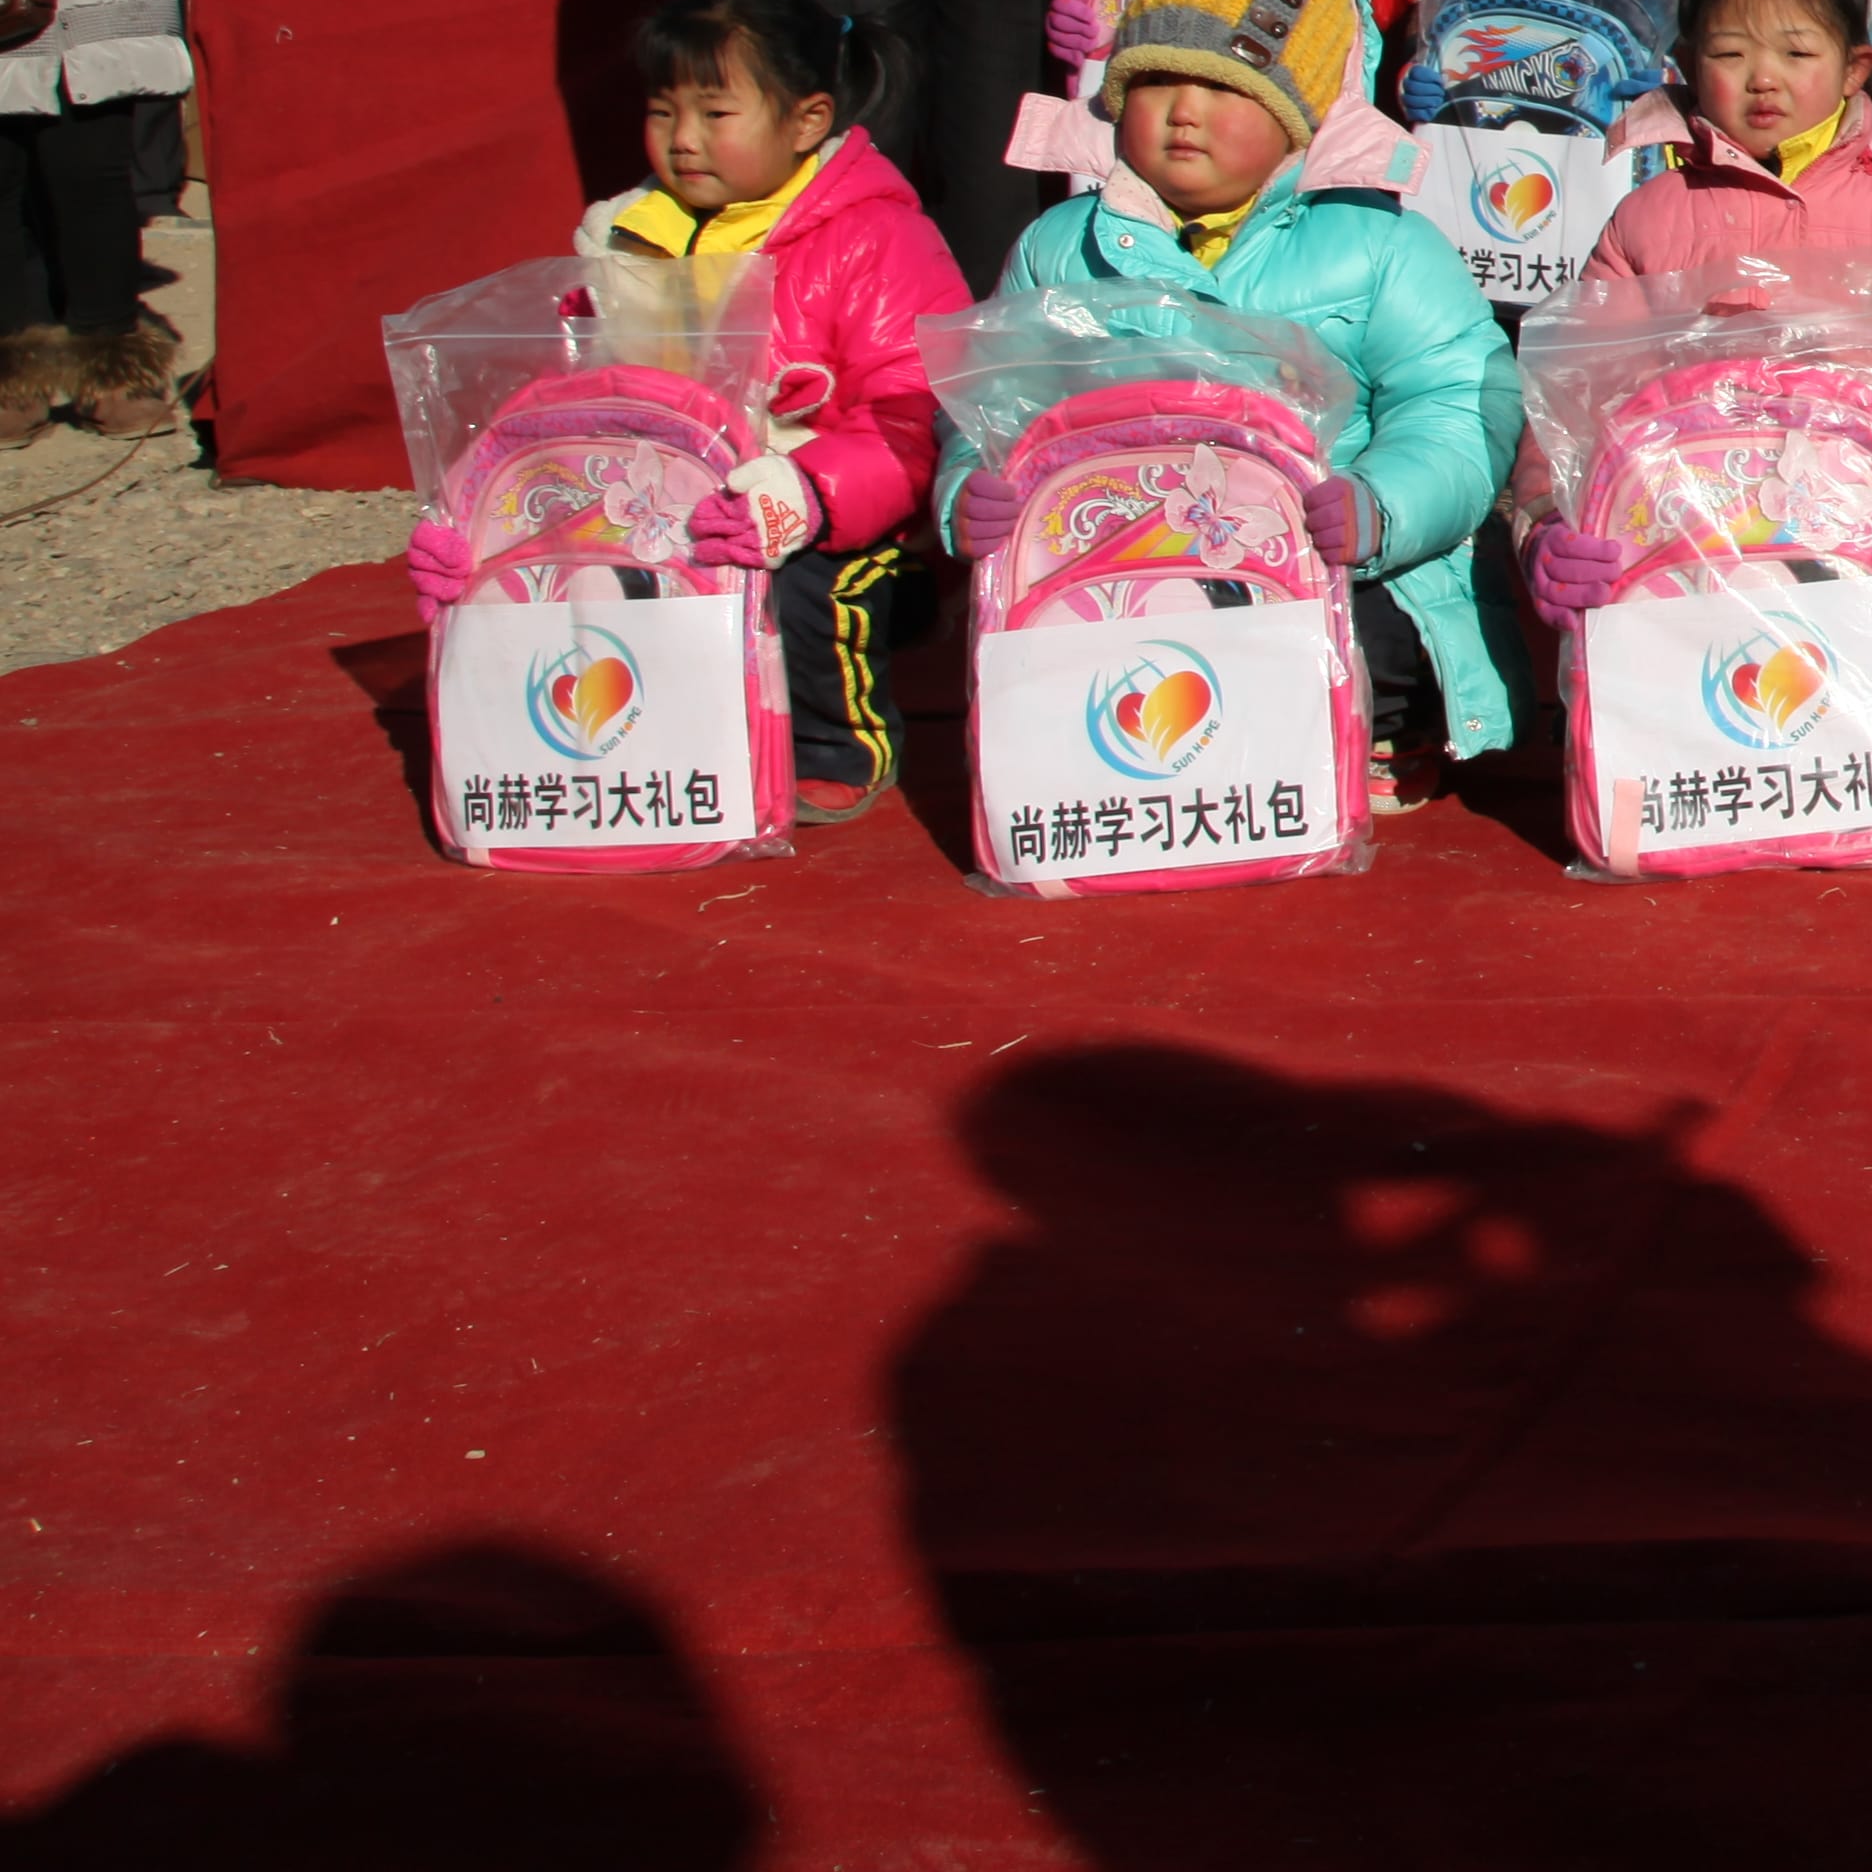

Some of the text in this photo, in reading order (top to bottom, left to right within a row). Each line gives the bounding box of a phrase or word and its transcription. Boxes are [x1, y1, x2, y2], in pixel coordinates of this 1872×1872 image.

[1458, 247, 1576, 294] 学习大礼
[463, 768, 725, 832] 尚赫学习大礼包
[1010, 779, 1310, 866] 尚赫学习大礼包
